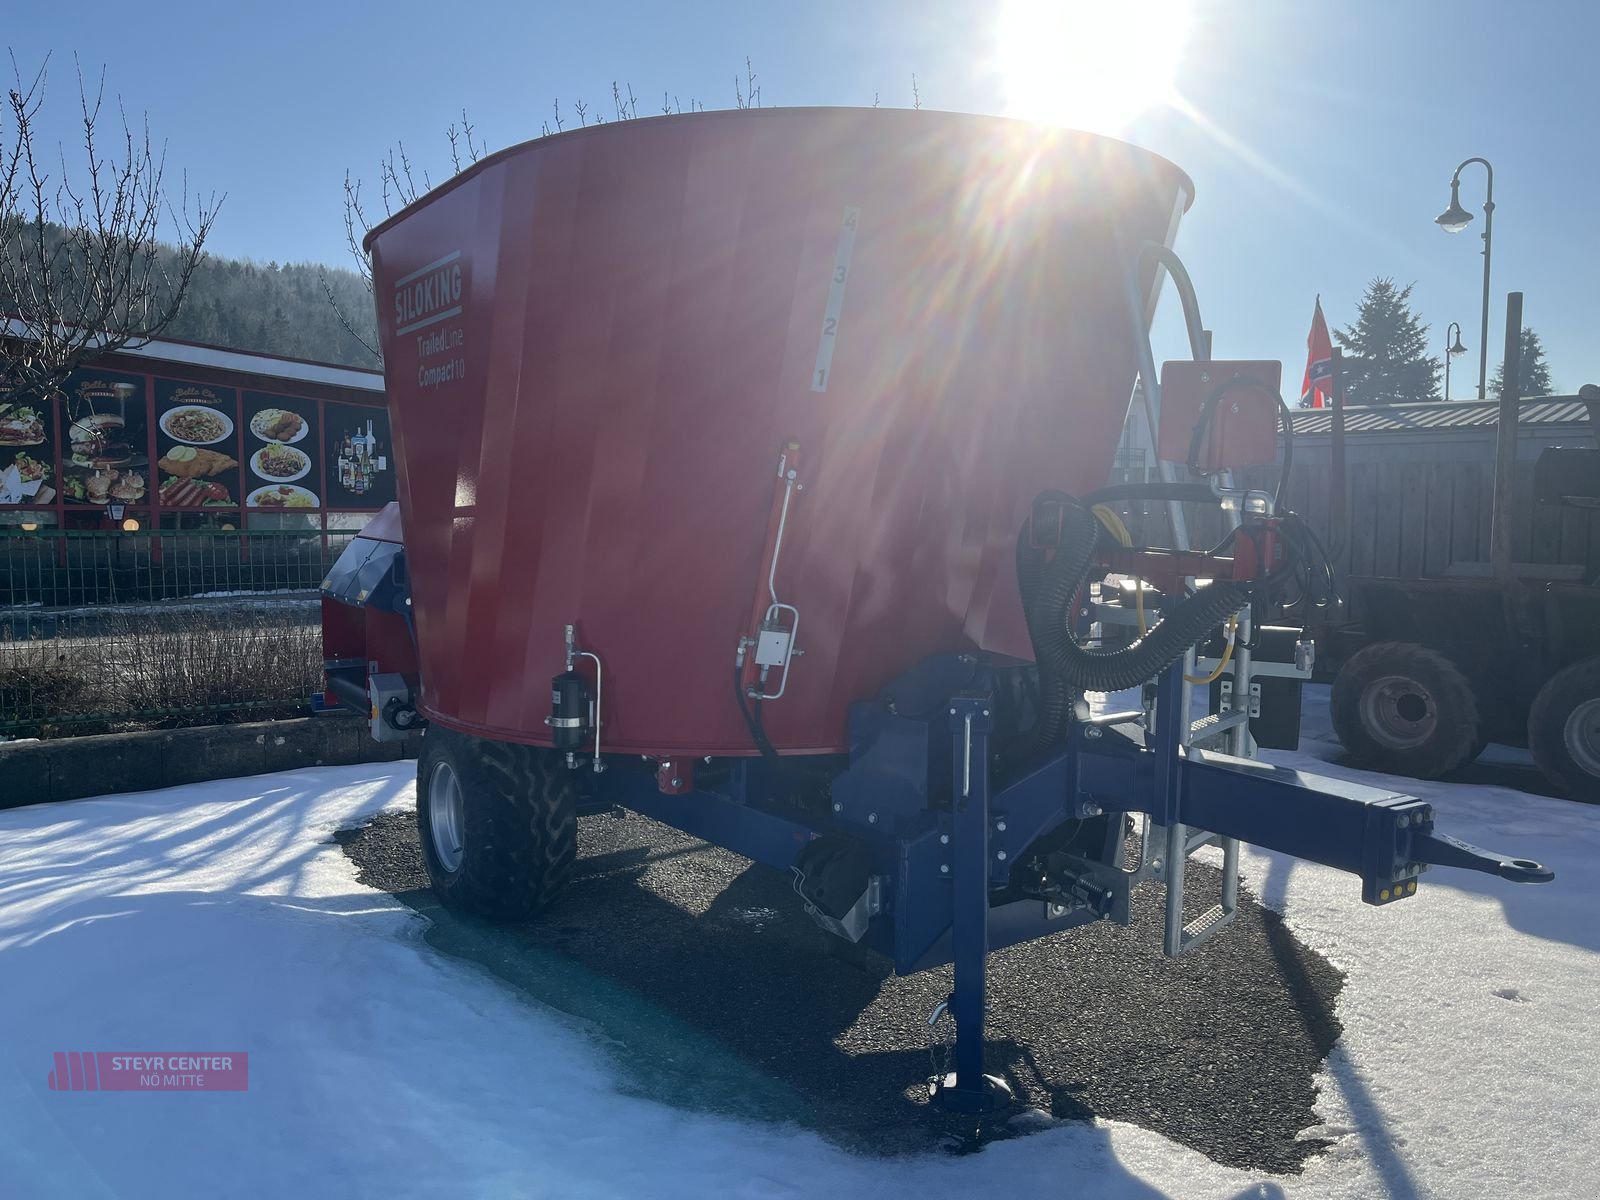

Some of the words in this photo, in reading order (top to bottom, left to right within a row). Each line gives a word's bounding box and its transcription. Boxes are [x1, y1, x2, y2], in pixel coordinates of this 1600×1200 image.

[845, 213, 857, 231] 4
[834, 265, 847, 284] 3
[395, 264, 462, 324] SILOKING
[824, 318, 837, 336] 2
[417, 328, 463, 357] TrailedLine
[817, 369, 826, 386] 1
